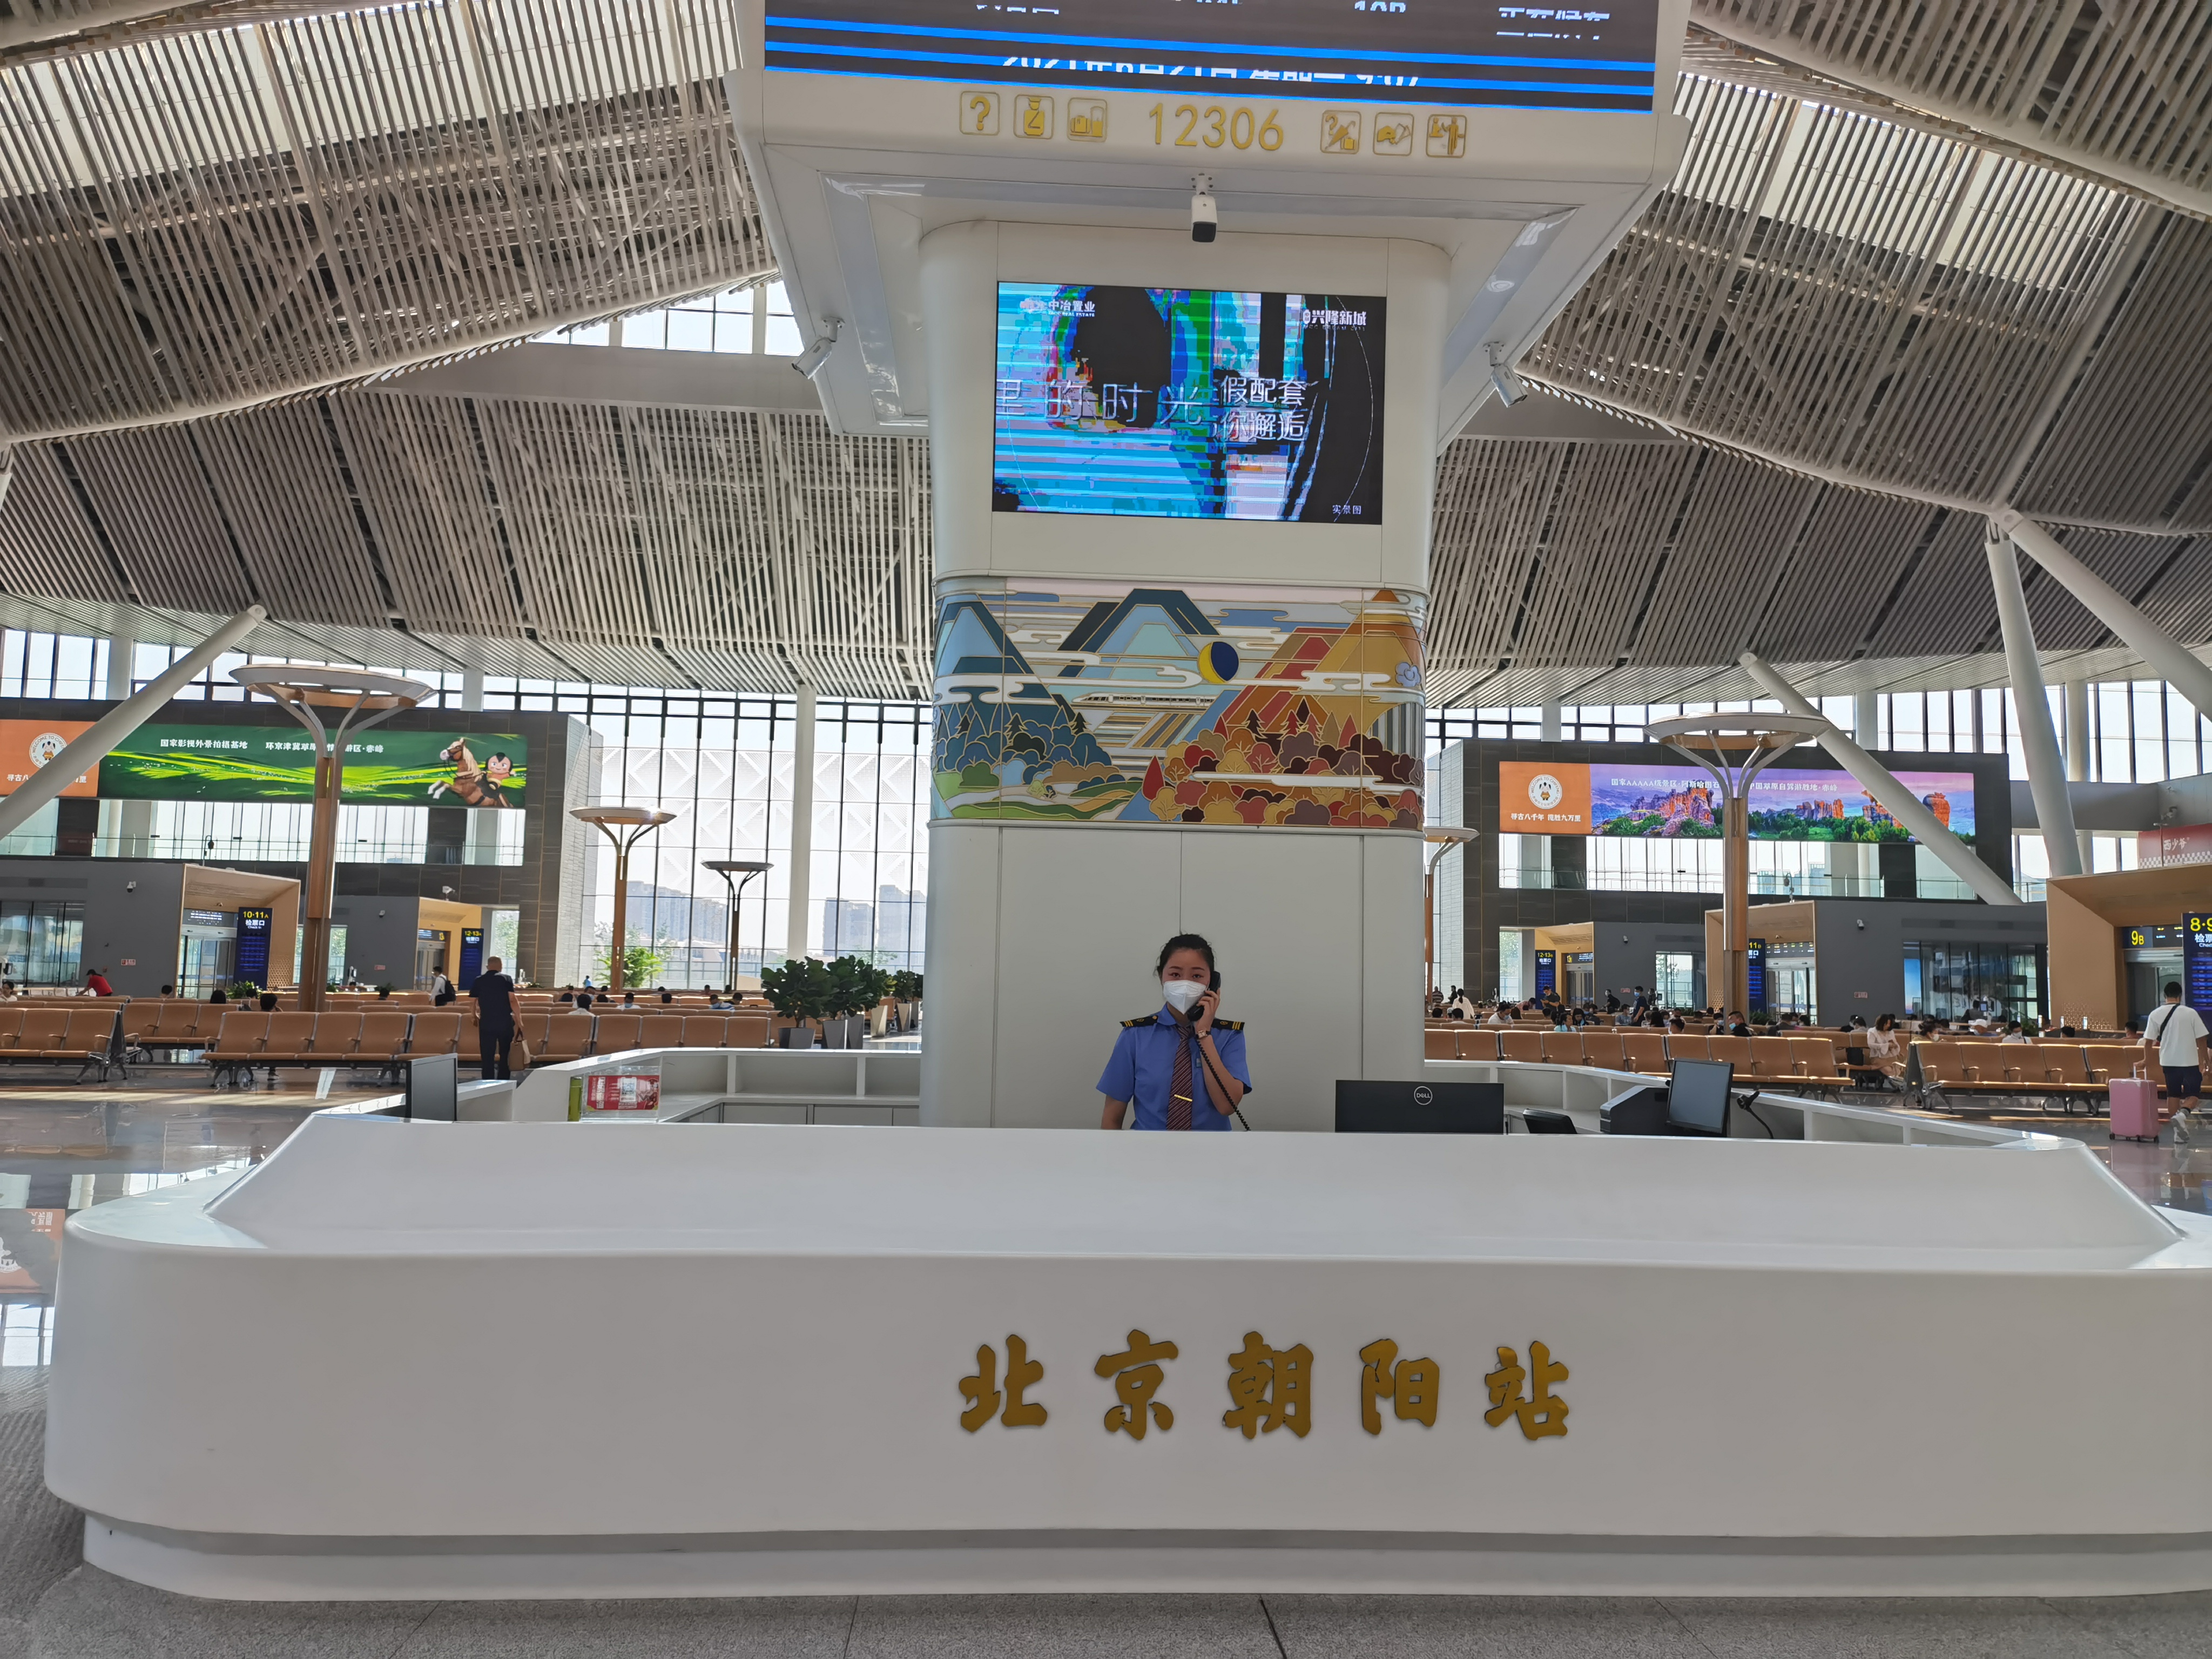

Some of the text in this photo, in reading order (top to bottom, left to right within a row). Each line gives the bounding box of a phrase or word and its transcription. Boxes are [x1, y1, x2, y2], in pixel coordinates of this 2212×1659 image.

[1149, 103, 1284, 151] 12306
[1049, 299, 1095, 313] 中冶置业
[1312, 310, 1367, 325] 兴隆新城
[1332, 505, 1361, 515] 实景图
[160, 739, 248, 749] 国家影视外景拍摄基地
[1510, 813, 1545, 821] 寻古八千年
[958, 1329, 1569, 1441] 北京朝阳站
